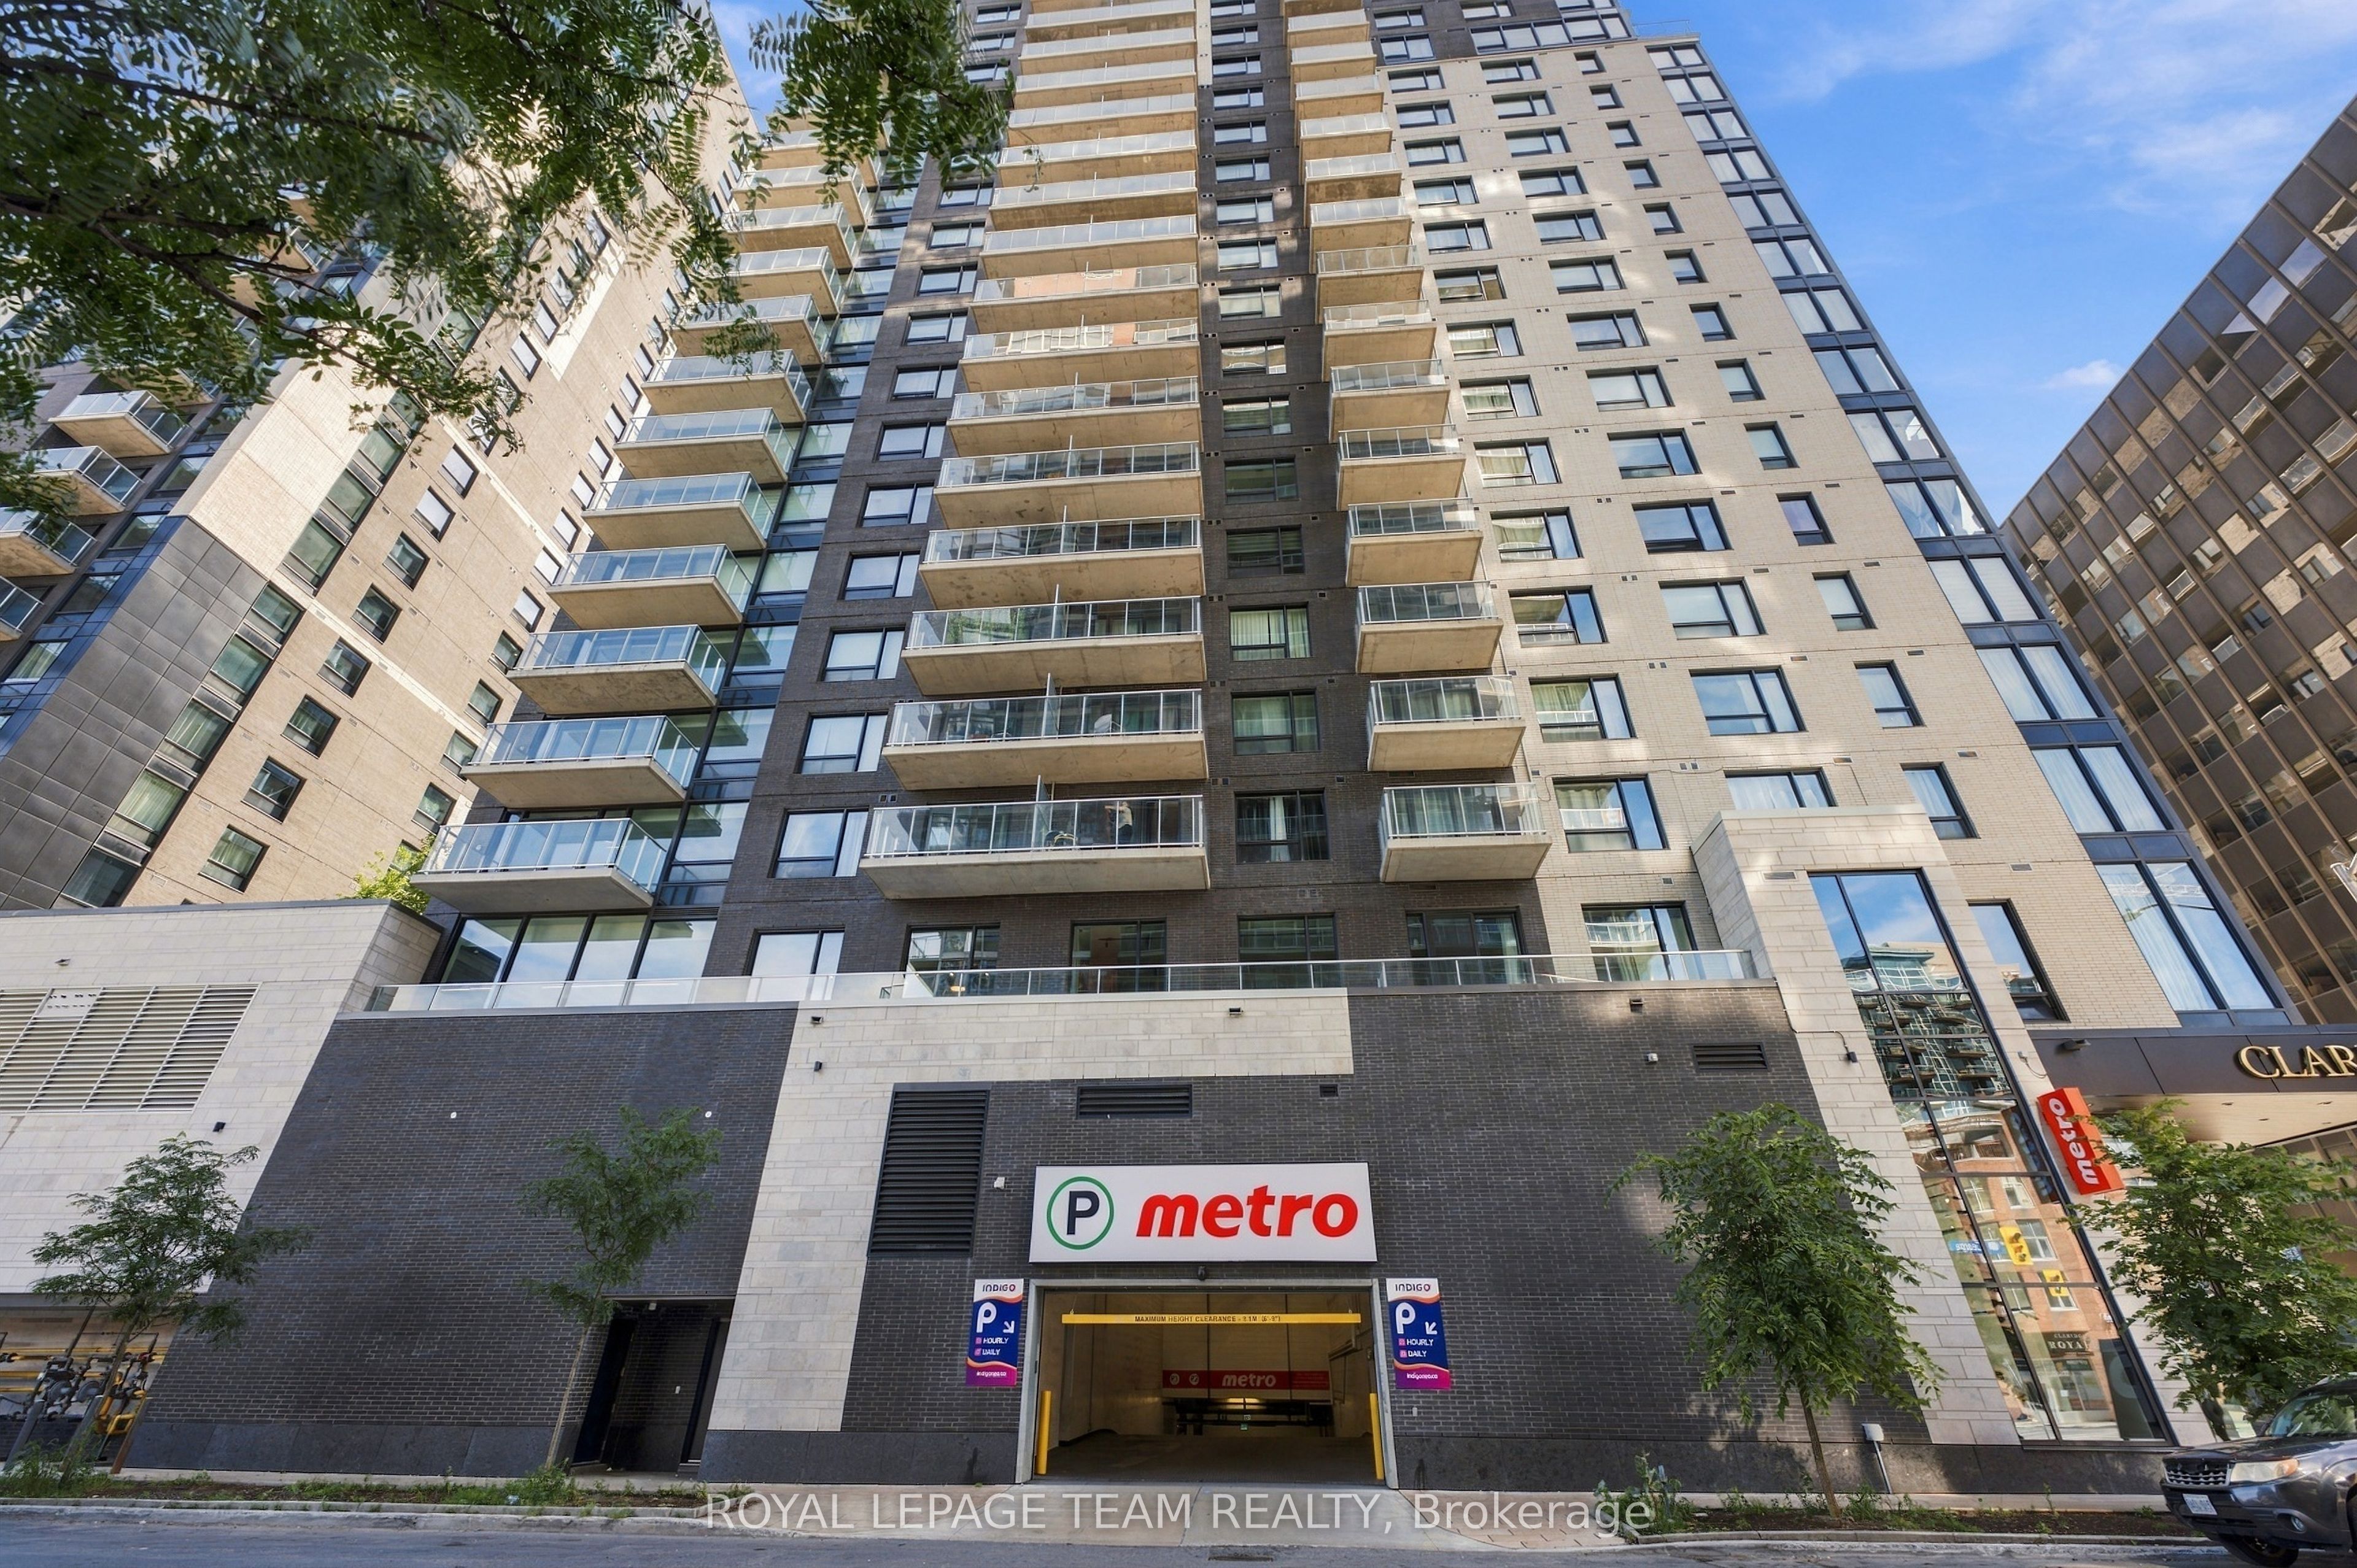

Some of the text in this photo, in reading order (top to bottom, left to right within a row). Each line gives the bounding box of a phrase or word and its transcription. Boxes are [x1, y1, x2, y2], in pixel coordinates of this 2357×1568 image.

[2239, 1045, 2357, 1078] CLAR
[2049, 1098, 2099, 1184] metro
[1067, 1185, 1358, 1238] P metro
[1395, 1283, 1431, 1292] INDIGO
[976, 1302, 997, 1333] P
[1395, 1302, 1416, 1334] P
[1221, 1373, 1277, 1387] metro
